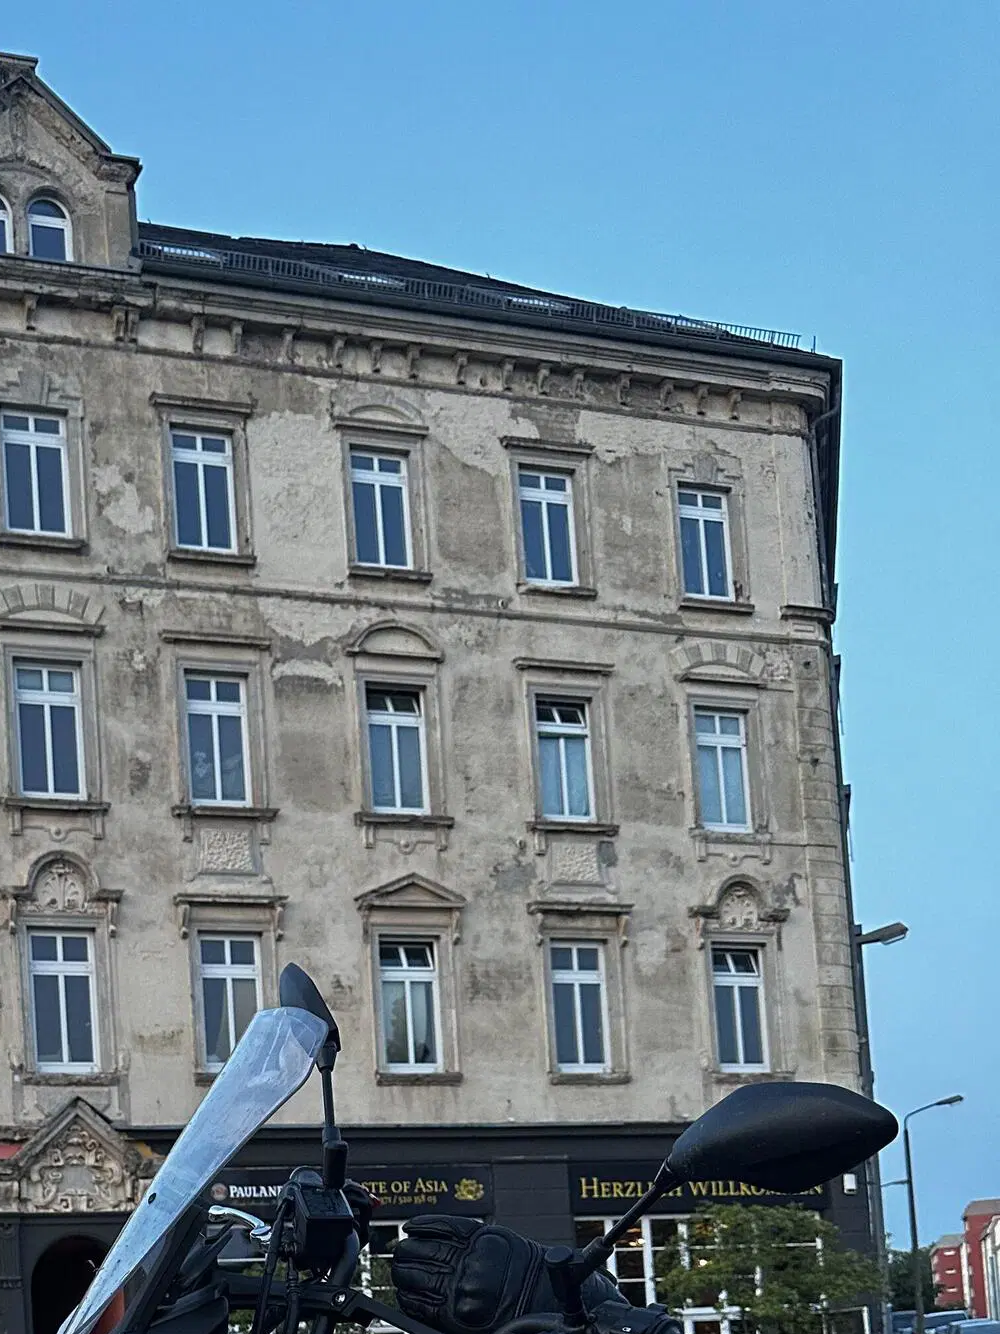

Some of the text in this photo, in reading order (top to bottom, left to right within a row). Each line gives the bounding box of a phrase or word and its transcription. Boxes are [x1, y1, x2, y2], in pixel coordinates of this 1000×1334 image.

[229, 1184, 283, 1198] PAULANE
[391, 1180, 411, 1193] OF
[414, 1177, 448, 1193] ASIA
